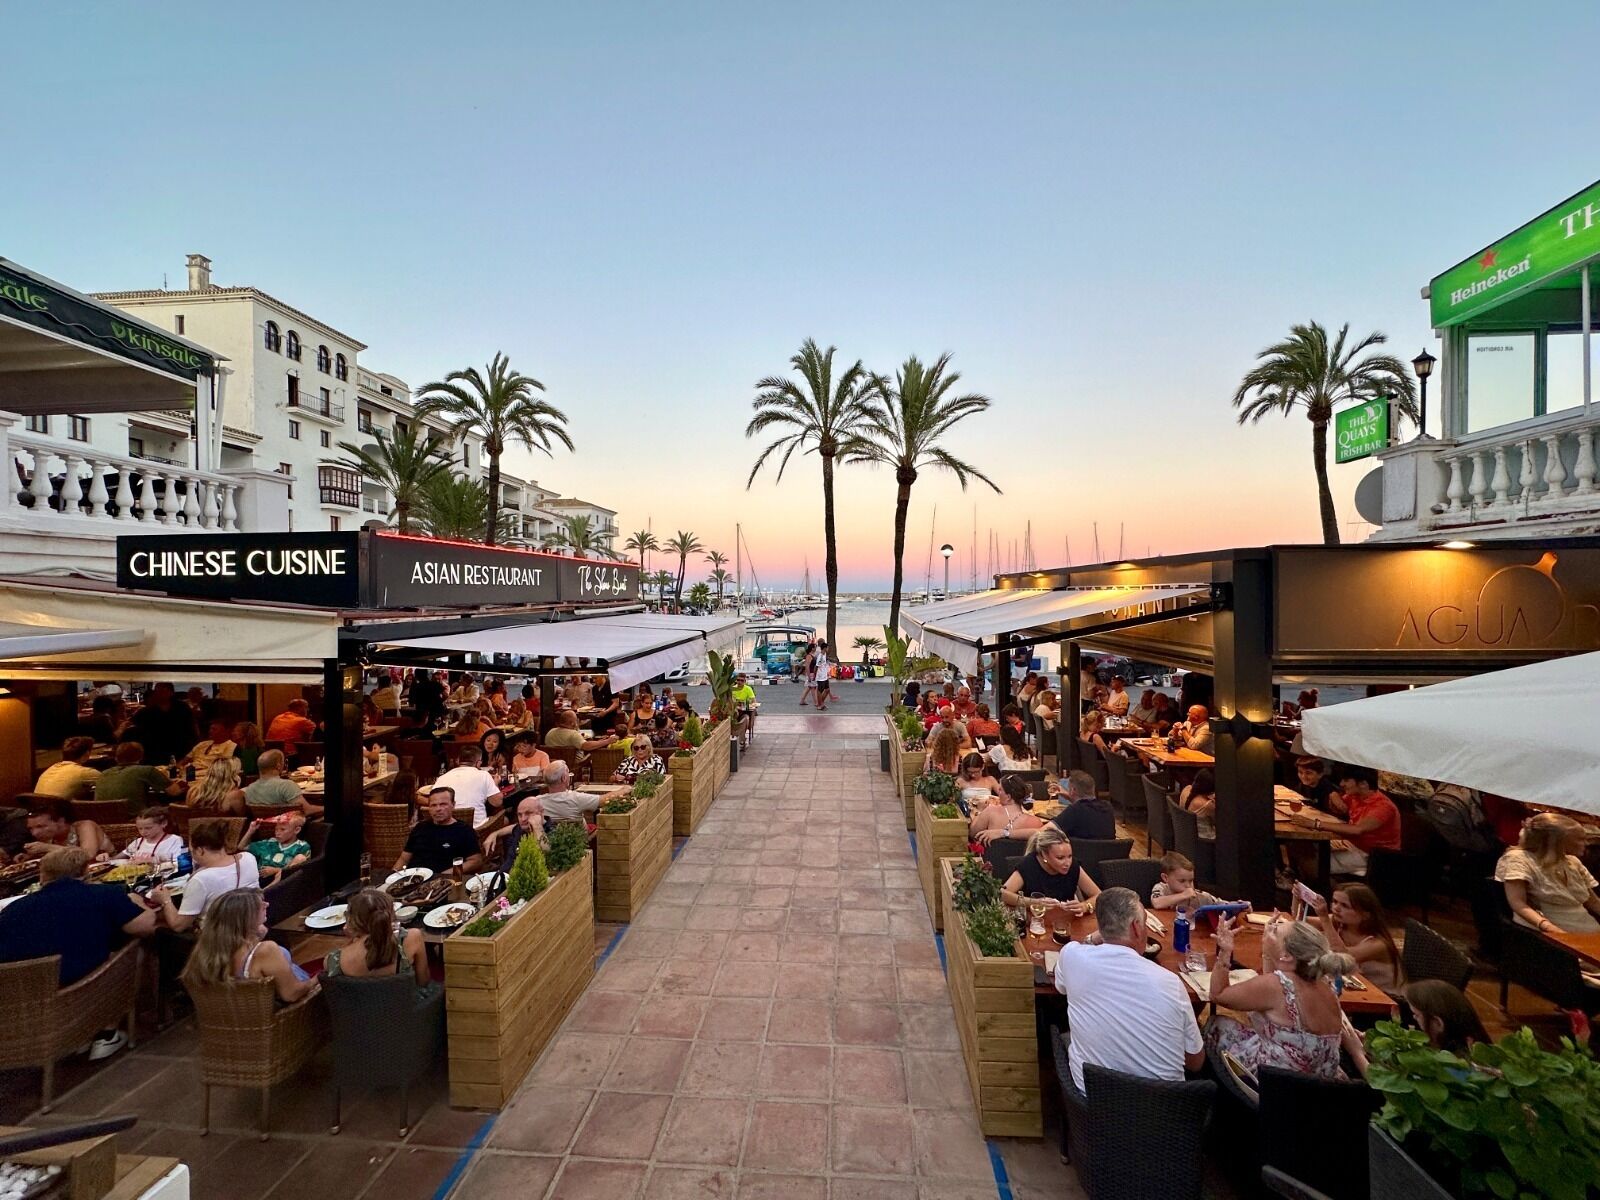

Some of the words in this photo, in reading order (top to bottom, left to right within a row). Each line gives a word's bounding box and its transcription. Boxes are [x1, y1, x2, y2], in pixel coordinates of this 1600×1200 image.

[1450, 257, 1531, 306] Heineken
[0, 285, 49, 310] ale
[127, 327, 201, 367] kinsale
[1349, 415, 1366, 429] THE
[1338, 423, 1376, 449] QUAYS
[1340, 444, 1362, 459] IRISH
[1364, 440, 1382, 452] BAR
[129, 550, 237, 577] CHINESE
[246, 549, 346, 576] CUISINE
[410, 561, 460, 585] ASIAN
[464, 564, 543, 586] RESTAURANT
